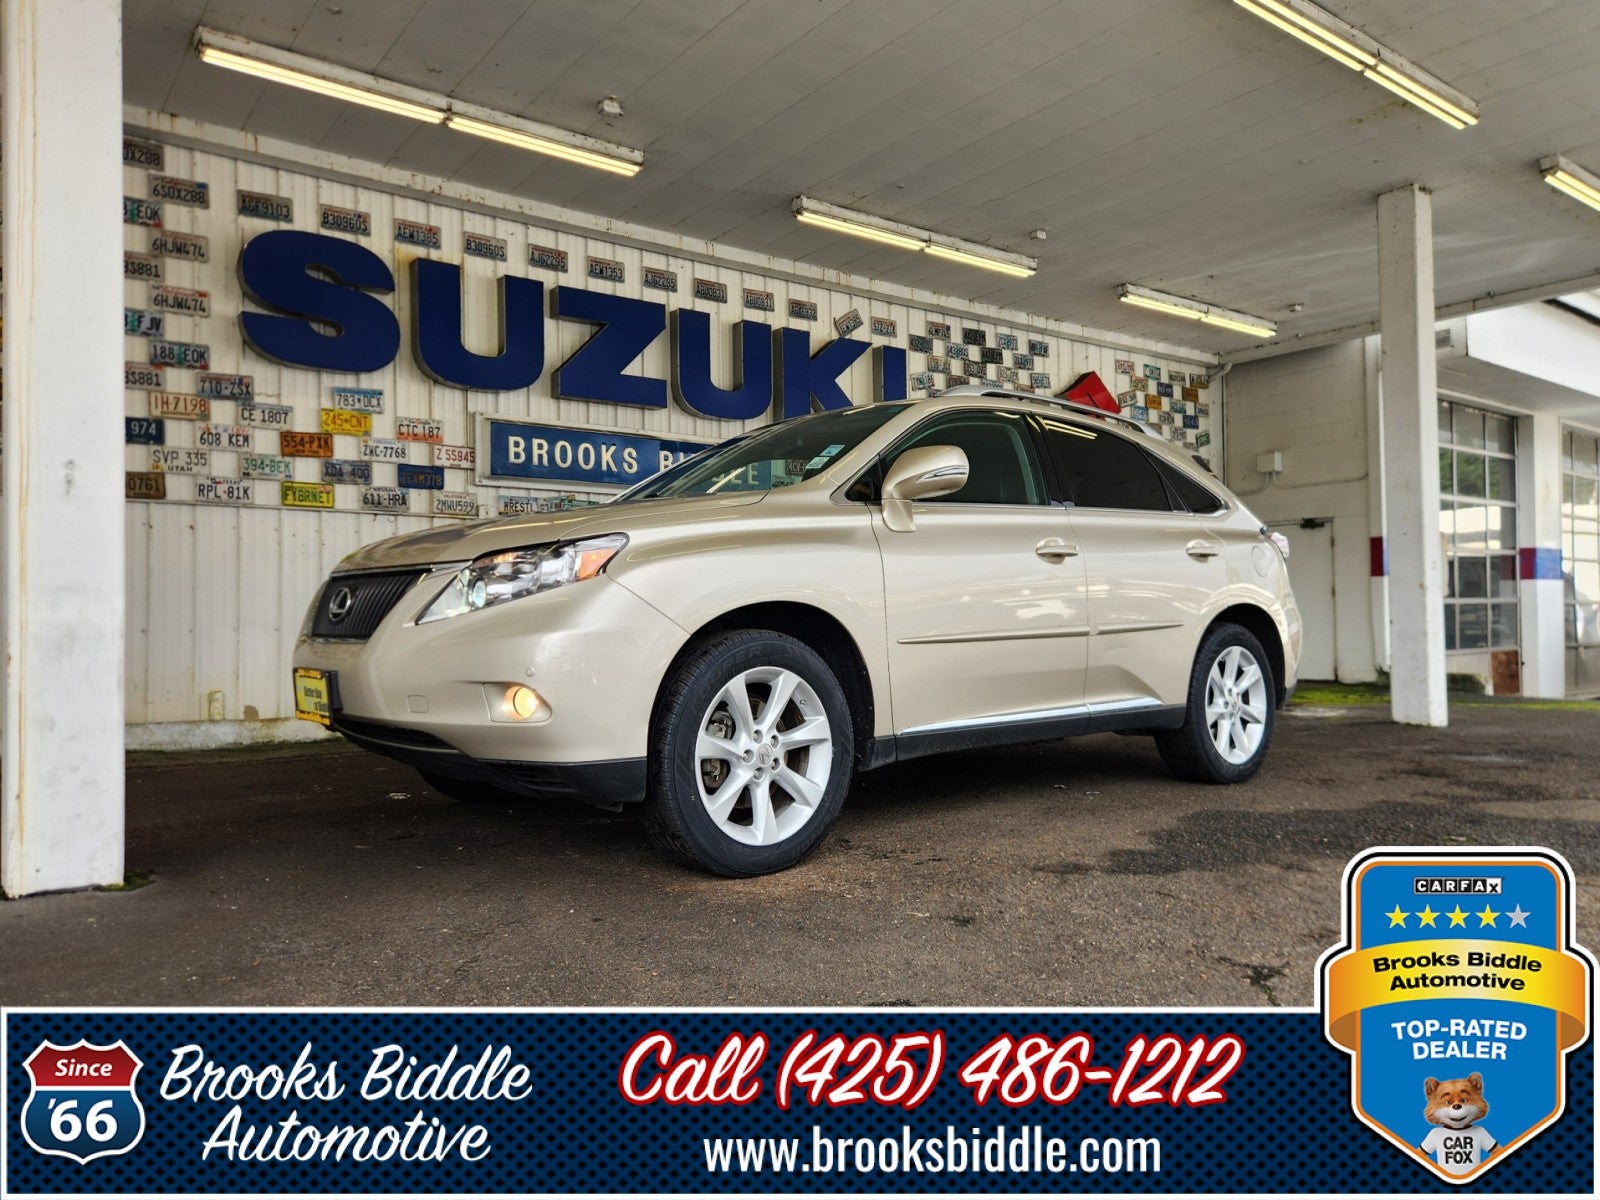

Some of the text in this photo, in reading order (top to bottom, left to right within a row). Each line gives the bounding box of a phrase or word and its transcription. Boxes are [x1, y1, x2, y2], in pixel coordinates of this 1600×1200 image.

[152, 238, 206, 258] 6HJW474
[153, 293, 207, 313] 6HJW474
[238, 229, 907, 421] SUZUKI
[153, 344, 175, 363] 188
[241, 406, 289, 425] CE 1807
[130, 420, 157, 436] 974
[398, 423, 419, 438] CTC
[422, 426, 441, 440] 187
[199, 432, 250, 448] 608 KEM
[152, 449, 208, 467] SVP 335
[445, 448, 475, 463] 55945
[507, 435, 639, 475] BROOKS
[168, 465, 193, 473] UTAH
[284, 484, 331, 504] FYBRNET
